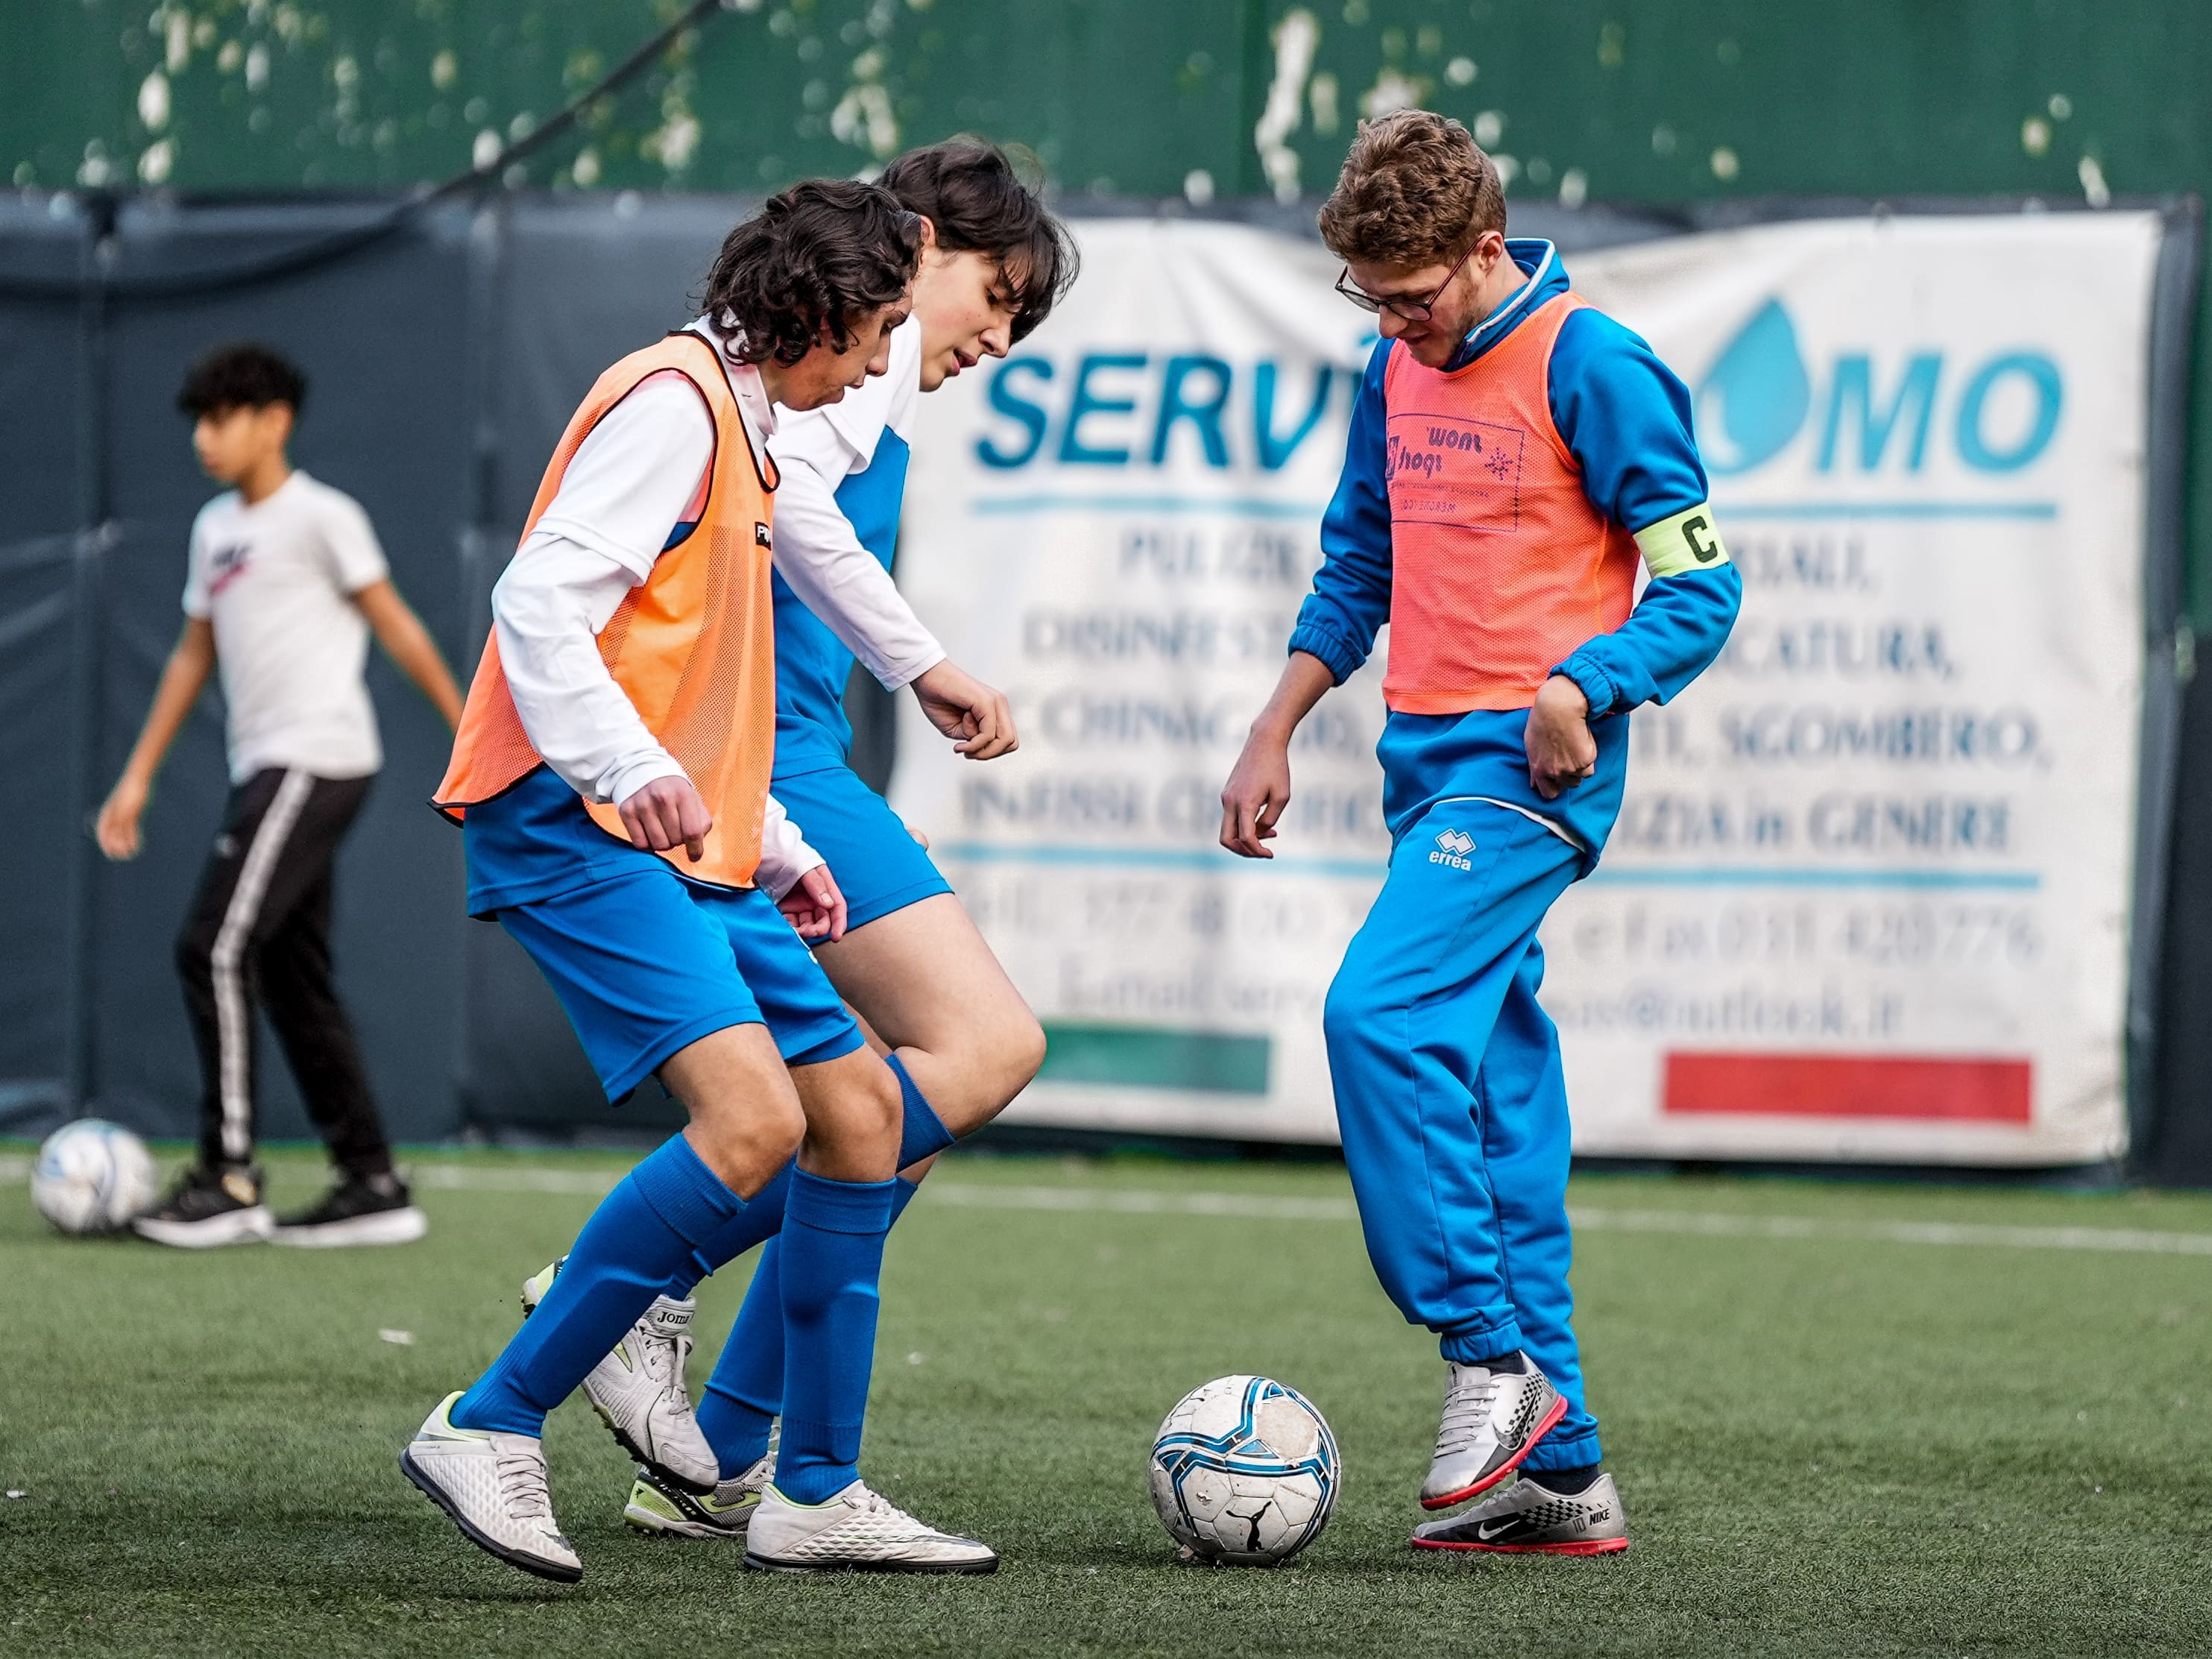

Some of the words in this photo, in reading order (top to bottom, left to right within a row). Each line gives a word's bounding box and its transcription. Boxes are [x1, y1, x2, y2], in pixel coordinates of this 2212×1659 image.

[975, 332, 1378, 471] SERV
[1682, 515, 1718, 563] C
[1429, 851, 1472, 871] errea
[1589, 1508, 1610, 1526] NIKE
